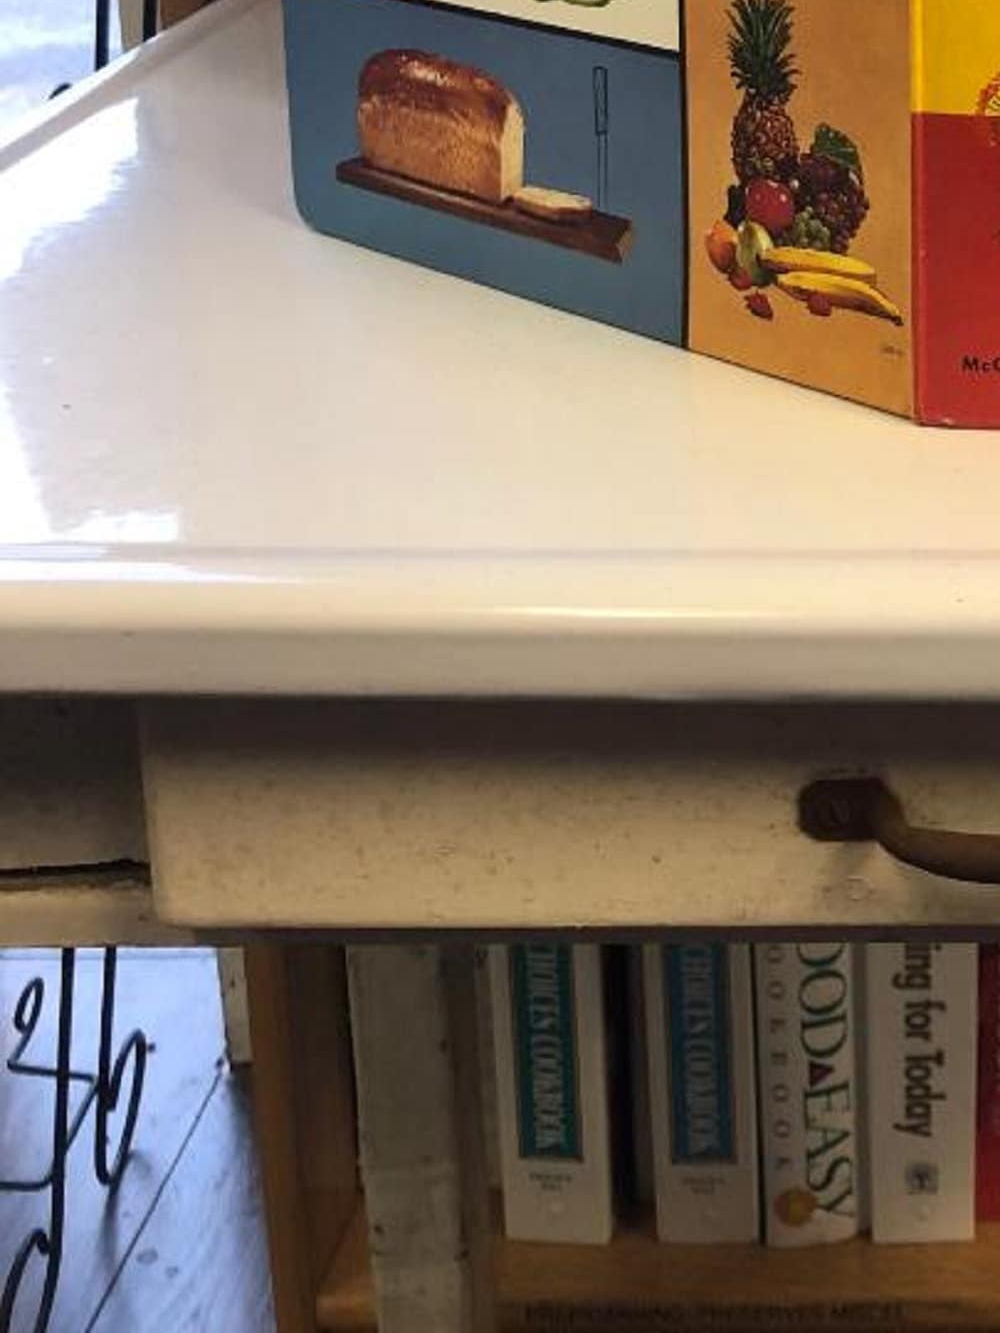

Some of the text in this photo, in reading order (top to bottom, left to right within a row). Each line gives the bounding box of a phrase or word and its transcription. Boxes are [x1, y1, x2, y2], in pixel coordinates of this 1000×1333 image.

[904, 999, 947, 1043] for
[892, 1048, 947, 1139] Today
[803, 1080, 857, 1219] EASY
